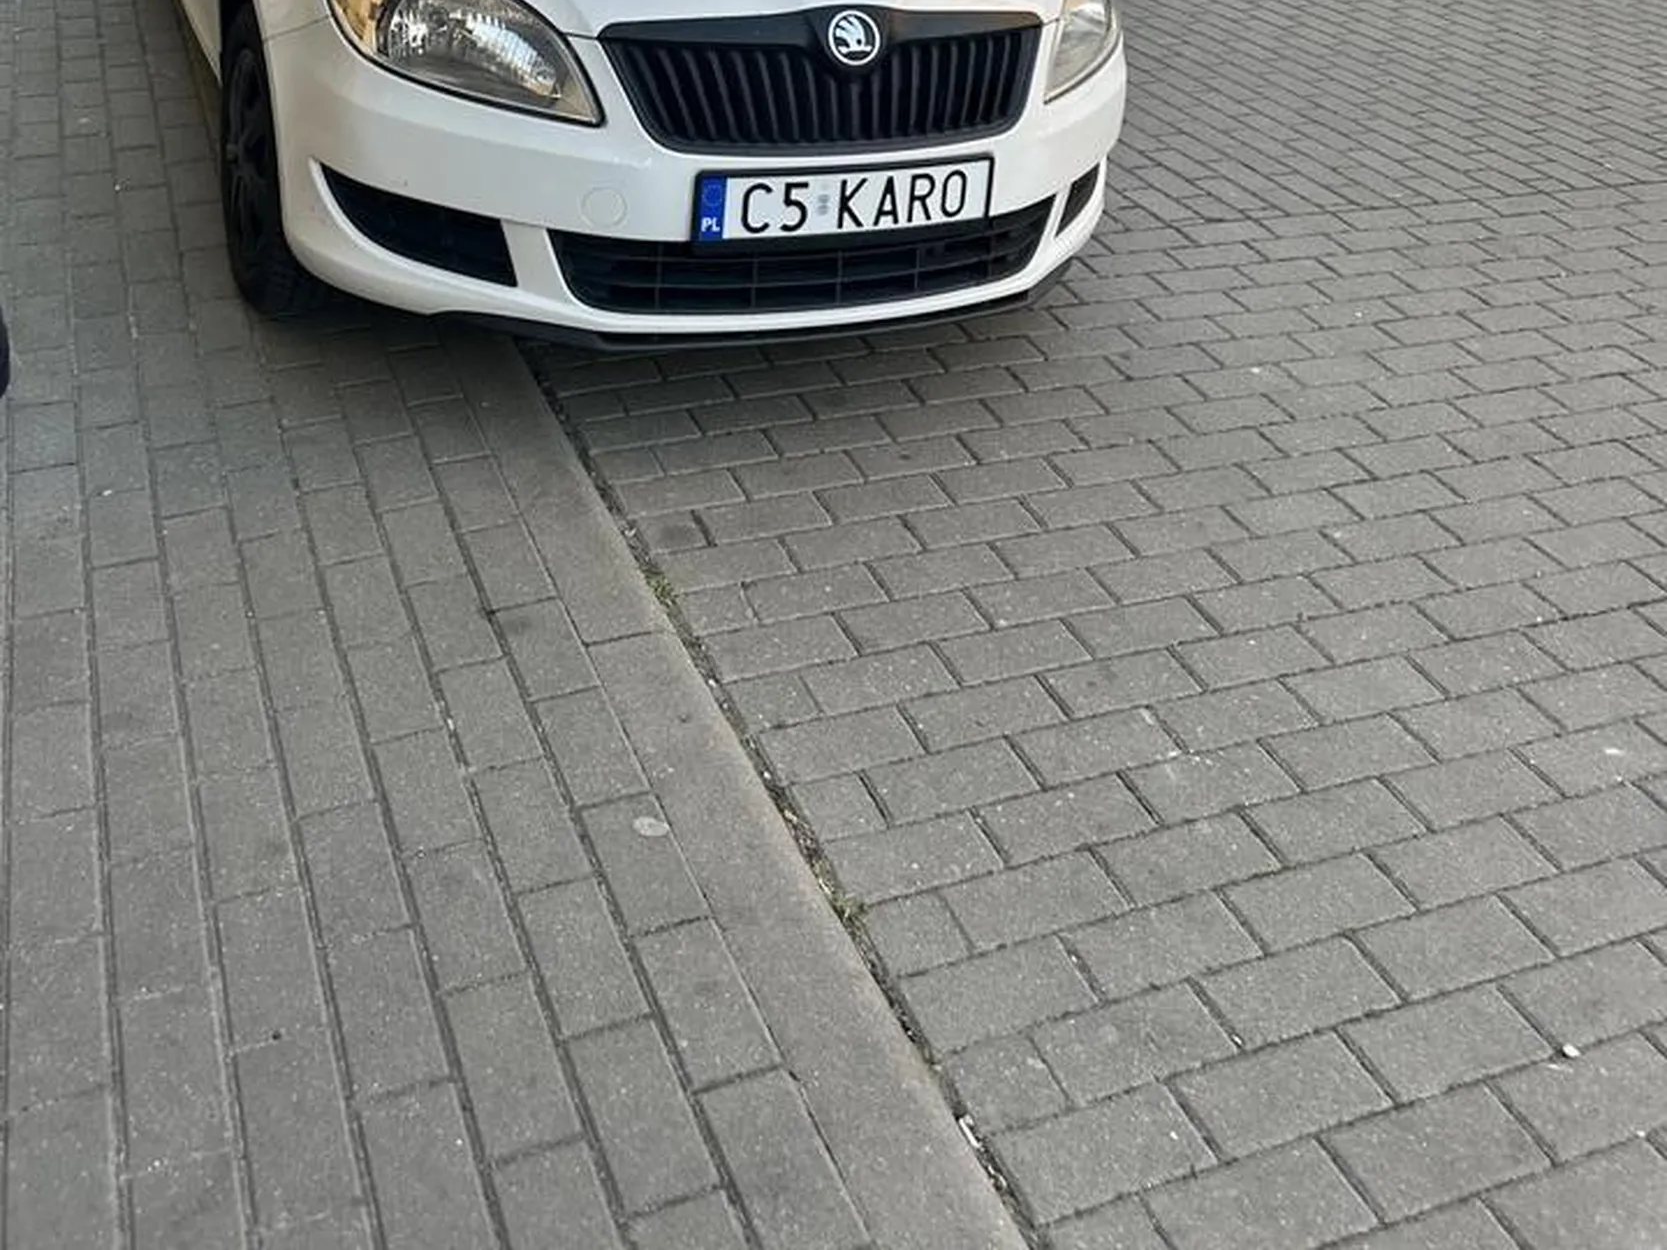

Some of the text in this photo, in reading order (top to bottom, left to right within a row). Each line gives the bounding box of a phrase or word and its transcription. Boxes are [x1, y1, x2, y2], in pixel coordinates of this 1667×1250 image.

[741, 169, 967, 233] C5 KARO
[701, 217, 721, 232] PL
